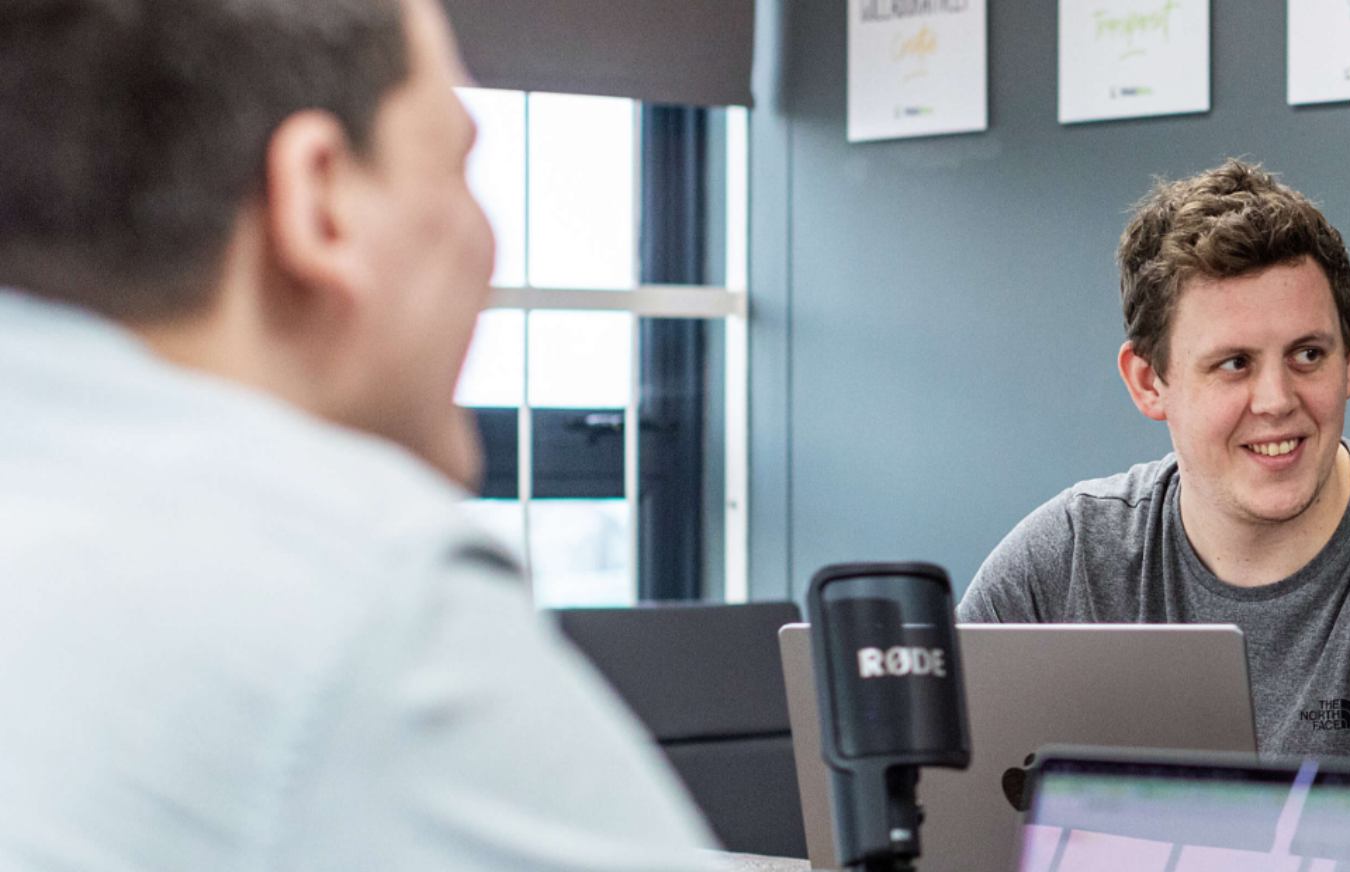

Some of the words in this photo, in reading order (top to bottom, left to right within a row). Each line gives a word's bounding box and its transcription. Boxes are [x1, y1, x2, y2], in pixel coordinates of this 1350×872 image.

[1319, 699, 1340, 710] THE
[1300, 709, 1340, 721] NORTH
[1312, 719, 1341, 731] FACE
